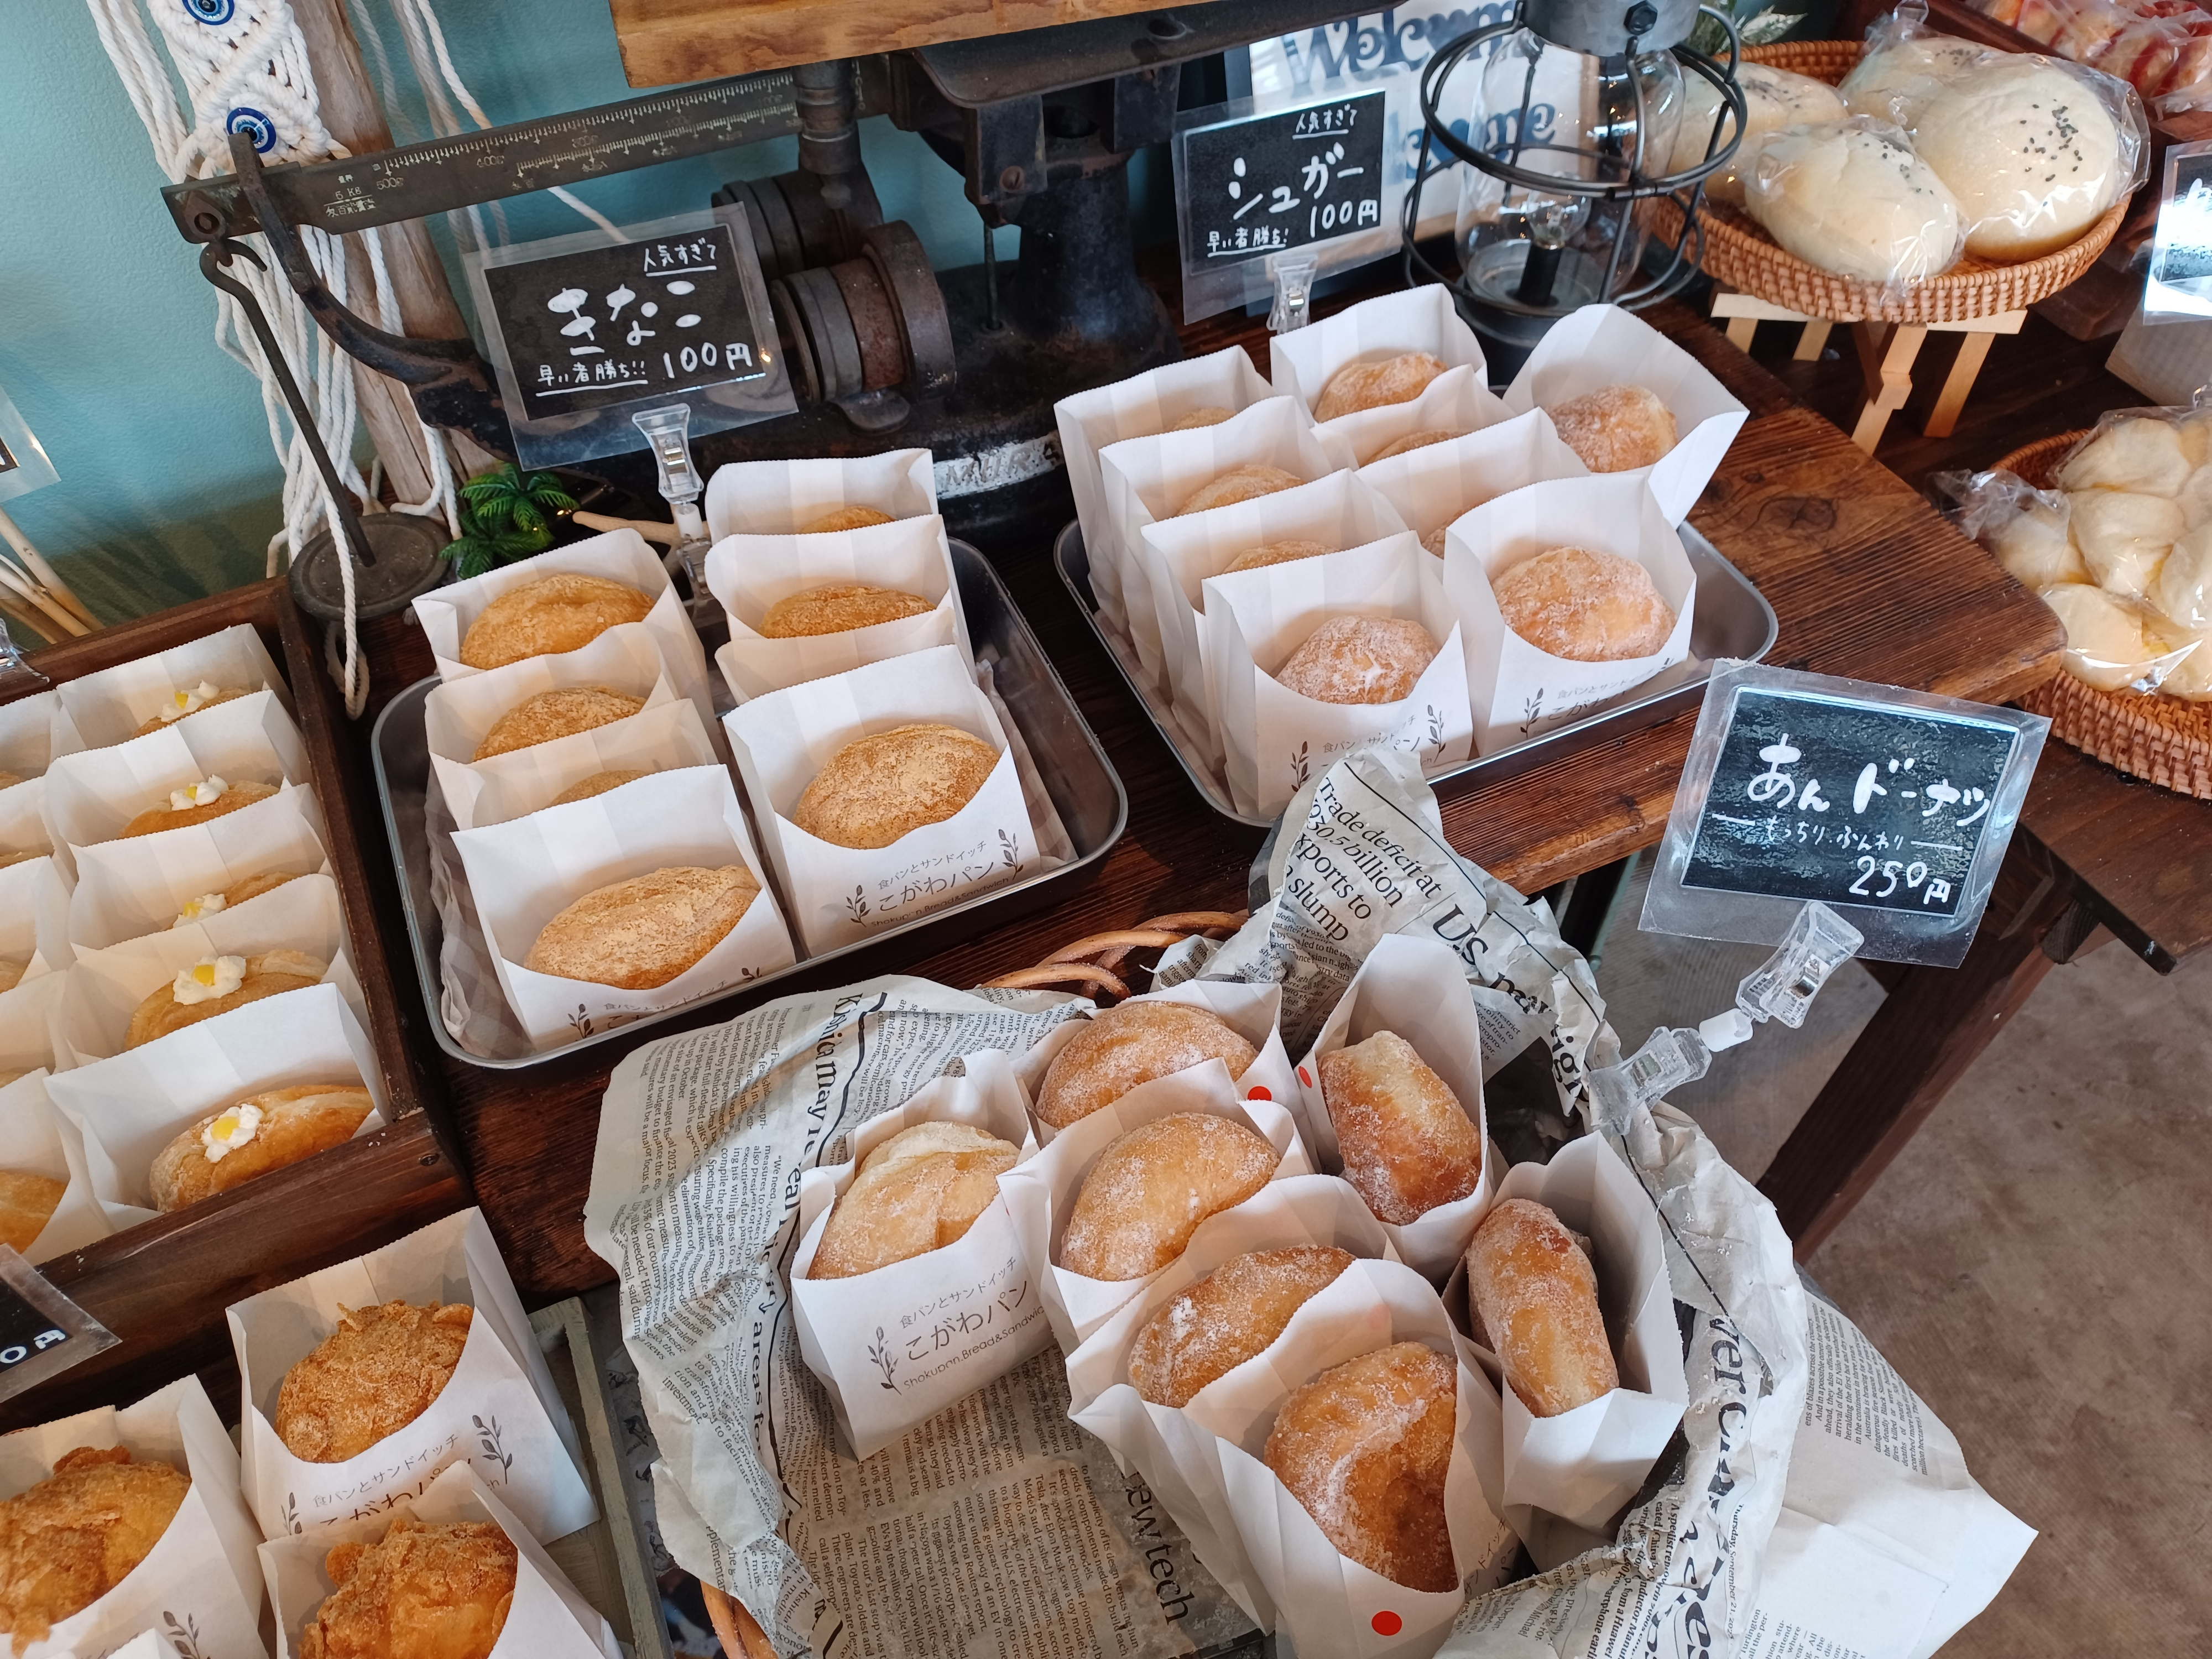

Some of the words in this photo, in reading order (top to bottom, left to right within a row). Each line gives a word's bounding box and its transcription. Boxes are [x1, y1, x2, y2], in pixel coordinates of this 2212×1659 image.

[1228, 142, 1364, 220] シュガー
[1310, 199, 1378, 238] 100円
[643, 237, 717, 272] 人気すぎて
[663, 341, 753, 378] 100円
[1306, 798, 1350, 846] 930.5
[1343, 843, 1402, 909] billion
[1315, 777, 1364, 832] Trade
[1361, 830, 1422, 878] deficit
[1416, 875, 1442, 899] at
[878, 840, 987, 891] 食パンとサンドイッチ
[1295, 832, 1354, 898] xports
[1348, 894, 1371, 919] to
[1849, 855, 1951, 904] 250円
[879, 861, 994, 912] こがわパン
[1288, 878, 1349, 941] slump
[1496, 1011, 1521, 1035] restrict
[678, 1067, 691, 1099] October.
[808, 1060, 837, 1121] may
[654, 1086, 666, 1115] budget
[688, 1088, 697, 1115] which
[653, 1129, 663, 1160] finance
[667, 1149, 676, 1171] 2023
[753, 1145, 761, 1165] also
[718, 1147, 728, 1187] compile
[741, 1146, 750, 1196] executives
[681, 1185, 693, 1239] elimination
[717, 1189, 727, 1204] the
[726, 1184, 739, 1241] willingness
[706, 1213, 717, 1248] Kishida
[714, 1207, 726, 1246] package
[899, 1256, 1016, 1329] 食パンとサンドイッチ
[905, 1280, 1027, 1361] こがわパン
[644, 1342, 664, 1360] news
[752, 1321, 764, 1406] areas
[903, 1305, 1045, 1391] Shokupan.Bread&Sandwic
[1806, 1377, 1815, 1401] blazes
[1826, 1388, 1835, 1405] they
[972, 1415, 984, 1438] work
[1010, 1419, 1019, 1434] the
[1032, 1408, 1048, 1450] alongside
[1824, 1408, 1834, 1434] ahead,
[1844, 1405, 1854, 1441] heralding
[1864, 1407, 1872, 1441] Australia
[1874, 1414, 1882, 1453] dangerous
[829, 1437, 841, 1469] moved
[958, 1409, 972, 1446] headway
[967, 1447, 979, 1478] they've
[977, 1438, 989, 1459] with
[996, 1412, 1008, 1442] telling
[1003, 1443, 1014, 1468] them
[1013, 1434, 1025, 1464] assem-
[1047, 1423, 1061, 1454] Toyota
[1060, 1426, 1074, 1452] liquid
[312, 1433, 458, 1508] 食パンとサンドイッチ
[930, 1449, 940, 1469] they
[940, 1441, 955, 1475] needed
[954, 1449, 966, 1482] electro-
[982, 1460, 991, 1475] the
[990, 1441, 1003, 1472] before
[1918, 1451, 1928, 1476] million
[815, 1442, 828, 1481] workers
[823, 1482, 834, 1519] demon-
[833, 1470, 841, 1483] on
[836, 1484, 843, 1494] to
[859, 1477, 867, 1487] or
[870, 1464, 881, 1484] 40%
[882, 1464, 895, 1504] improve
[910, 1480, 920, 1497] big
[920, 1465, 931, 1493] seam-
[933, 1470, 946, 1489] said
[947, 1475, 955, 1486] to
[812, 1488, 825, 1522] melted
[837, 1495, 847, 1516] Toy-
[874, 1488, 885, 1507] and
[988, 1489, 998, 1505] this
[1023, 1478, 1036, 1508] Model
[991, 1505, 1004, 1539] month.
[1035, 1474, 1046, 1501] Tesla,
[1045, 1522, 1056, 1545] Elon
[1051, 1546, 1066, 1573] Musk
[1067, 1509, 1083, 1544] current
[1078, 1499, 1100, 1558] components
[1094, 1559, 1112, 1592] needed
[862, 1559, 874, 1588] tour's
[898, 1548, 911, 1583] though,
[905, 1582, 917, 1617] Toyota
[953, 1500, 967, 1543] according
[965, 1561, 979, 1597] Reuters
[974, 1598, 987, 1632] report.
[970, 1525, 988, 1578] underbody
[990, 1610, 1001, 1624] EV
[982, 1535, 1000, 1571] gigacast
[994, 1573, 1014, 1627] technology
[1050, 1502, 1072, 1553] production
[1067, 1554, 1085, 1599] technique
[1078, 1600, 1101, 1652] pioneered
[1106, 1552, 1119, 1579] design
[1115, 1580, 1128, 1611] versus
[919, 1584, 929, 1610] Once
[1009, 1579, 1024, 1614] electric
[1145, 1543, 1195, 1626] tech
[935, 1604, 948, 1629] scale
[1022, 1579, 1040, 1629] billionaire
[1037, 1590, 1053, 1629] sections,
[964, 1621, 976, 1640] yet.
[1604, 1615, 1624, 1659] Huawei
[1778, 1624, 1792, 1654] attend-
[1787, 1626, 1801, 1653] where
